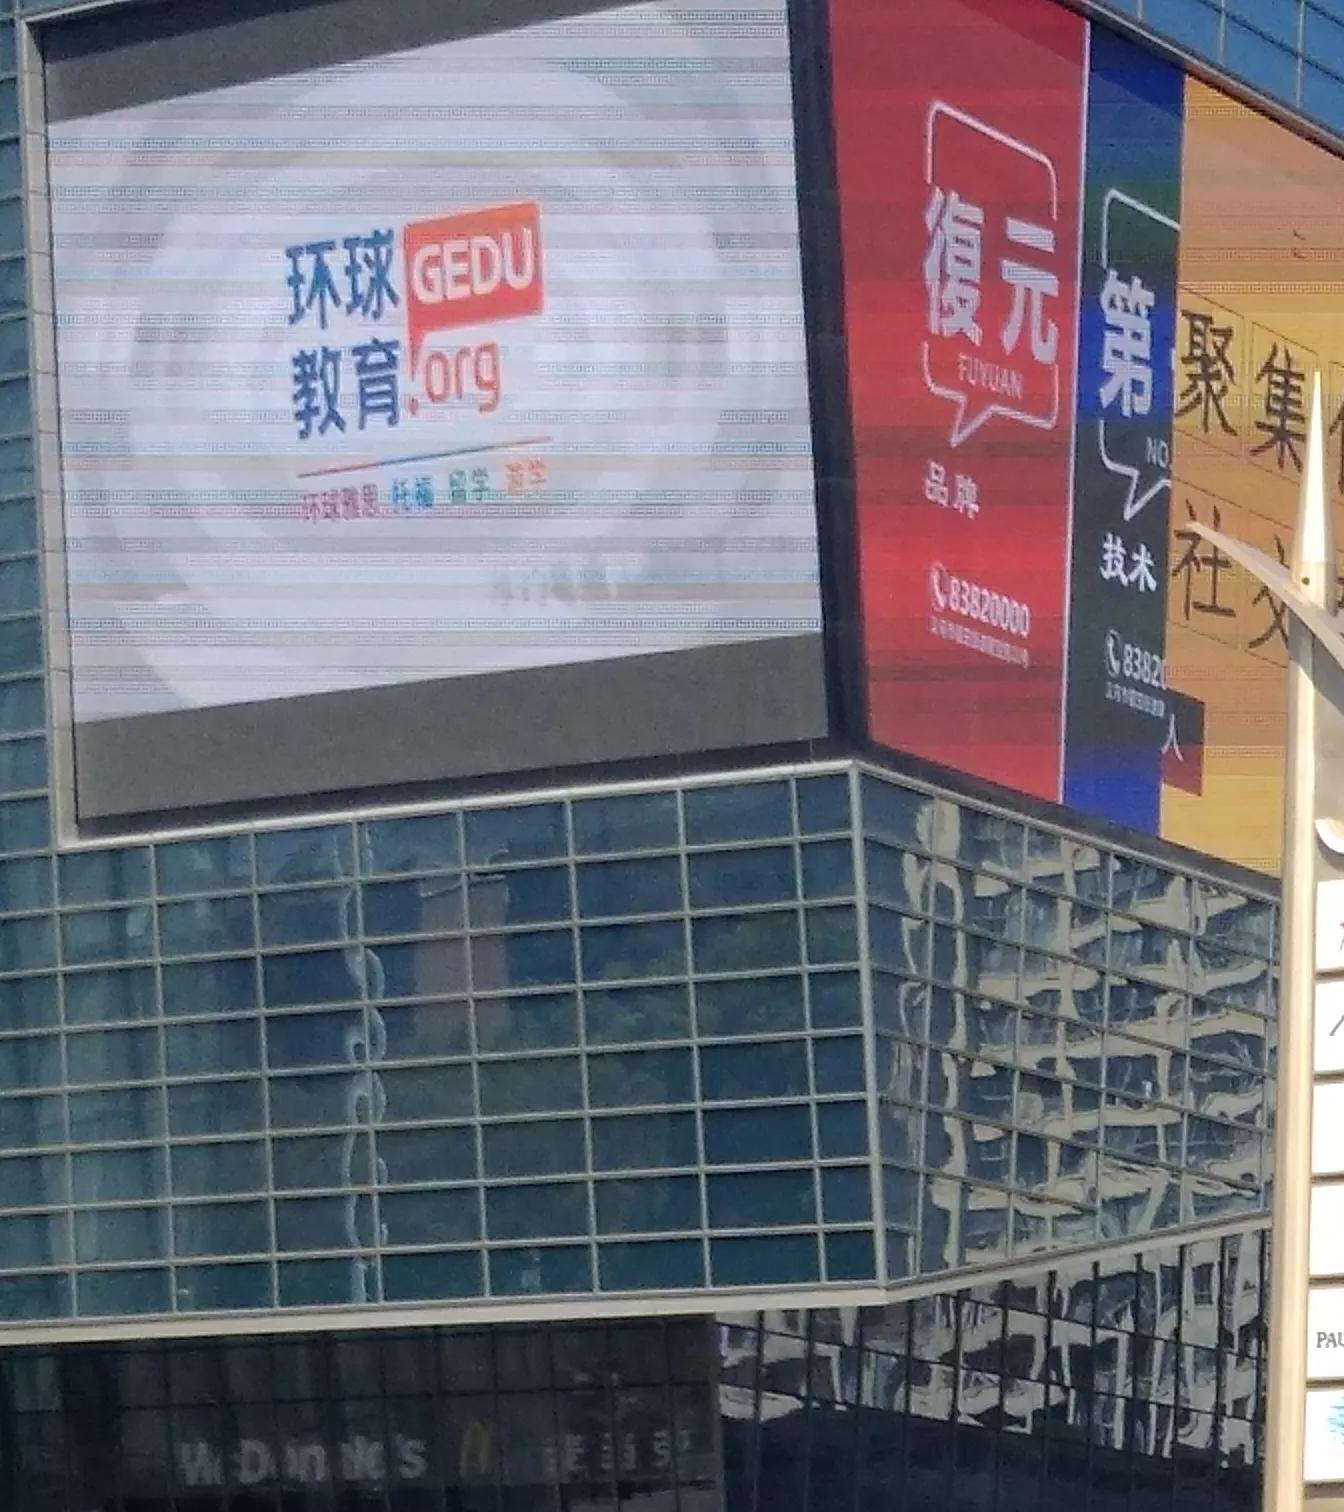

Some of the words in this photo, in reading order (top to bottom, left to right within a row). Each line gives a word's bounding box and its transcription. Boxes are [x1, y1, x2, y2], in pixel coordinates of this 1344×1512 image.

[285, 228, 400, 330] 环球
[412, 227, 534, 304] GEDU
[923, 186, 1059, 363] 復元
[293, 337, 400, 440] 教育
[959, 354, 1023, 399] FUYUAN
[1100, 532, 1157, 593] 技术
[949, 577, 1031, 638] 83820000
